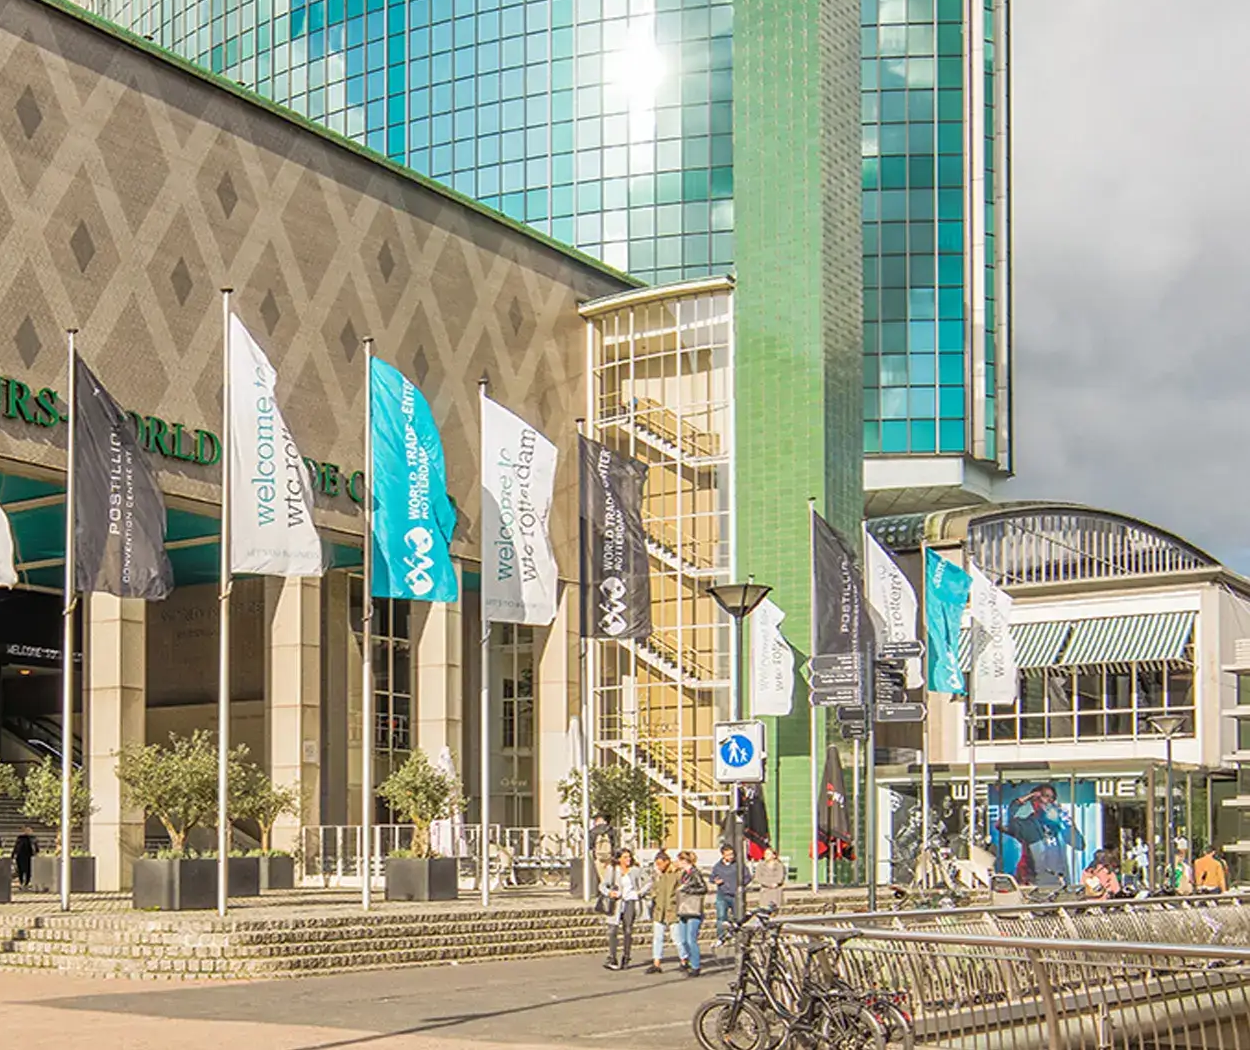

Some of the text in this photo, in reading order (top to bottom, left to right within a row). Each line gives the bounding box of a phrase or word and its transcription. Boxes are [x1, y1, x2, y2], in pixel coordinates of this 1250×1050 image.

[252, 395, 276, 527] welcome
[284, 478, 304, 528] wtc
[408, 471, 421, 520] WORLD
[494, 475, 516, 581] welcome
[603, 529, 615, 572] WORLD
[1095, 779, 1136, 797] WE
